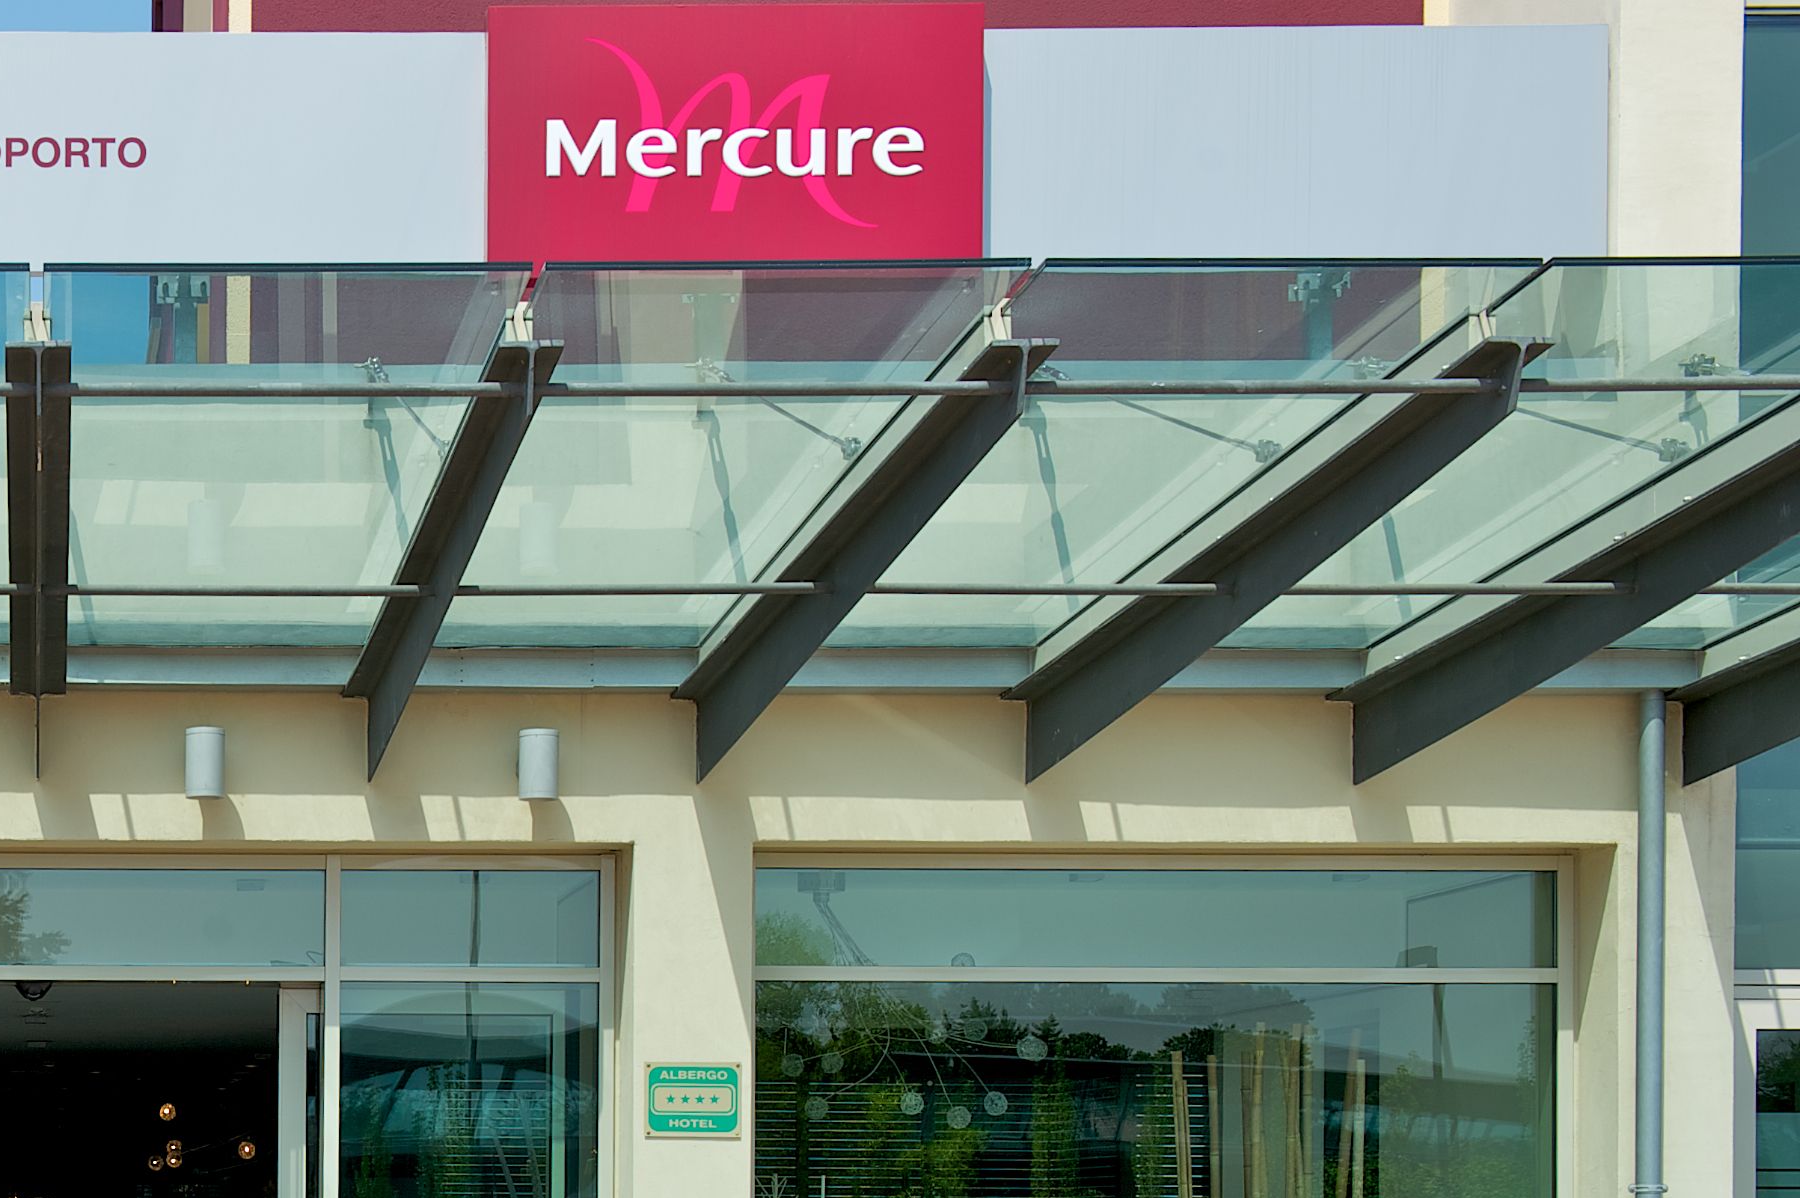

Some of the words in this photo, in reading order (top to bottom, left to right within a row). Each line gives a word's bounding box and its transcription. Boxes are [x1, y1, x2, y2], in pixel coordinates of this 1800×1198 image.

[545, 118, 925, 178] Mercure
[660, 1070, 728, 1080] ALBERGO
[668, 1119, 717, 1129] HOTEL
